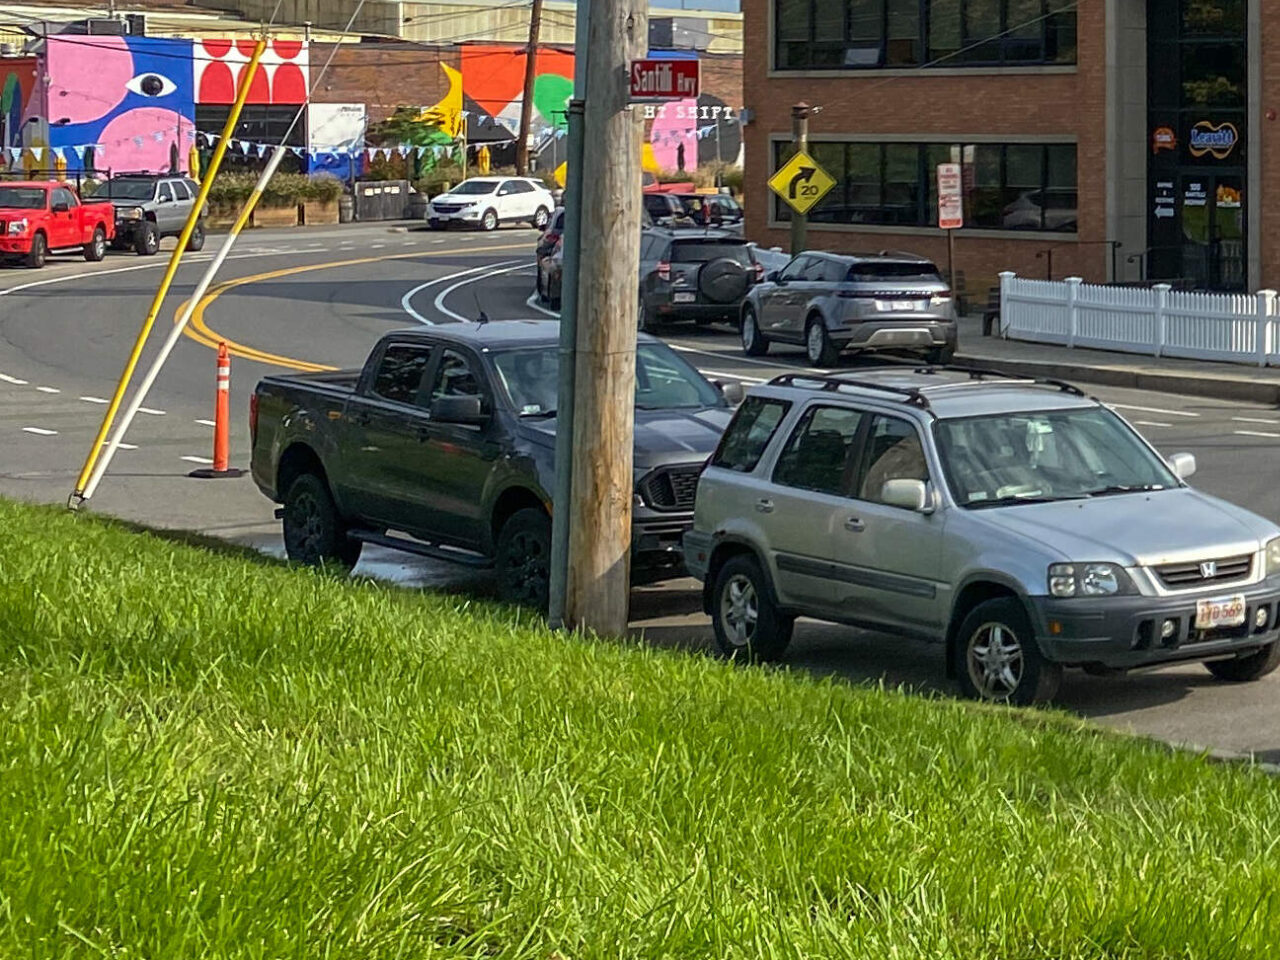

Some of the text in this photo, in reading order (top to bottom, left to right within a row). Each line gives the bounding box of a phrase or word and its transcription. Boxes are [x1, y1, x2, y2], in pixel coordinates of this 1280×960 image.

[633, 63, 697, 98] Santilli Hwy
[676, 105, 733, 119] SHIFT
[801, 185, 819, 196] 20
